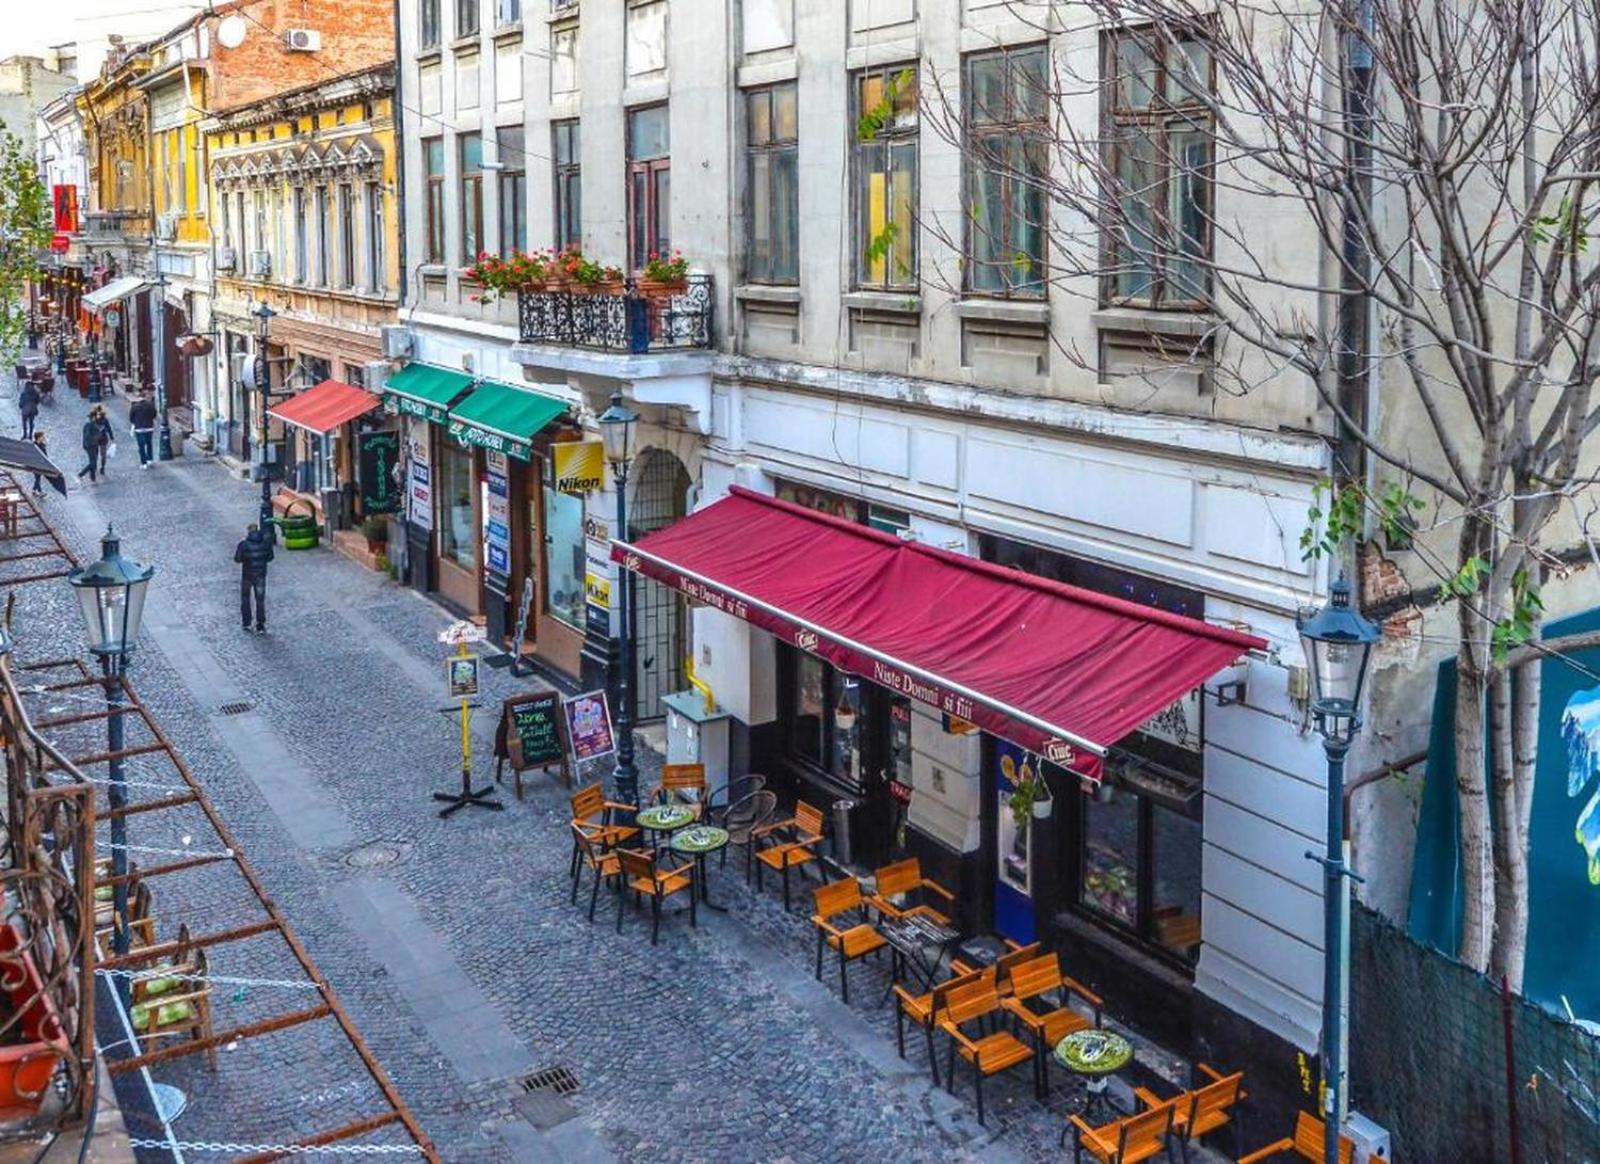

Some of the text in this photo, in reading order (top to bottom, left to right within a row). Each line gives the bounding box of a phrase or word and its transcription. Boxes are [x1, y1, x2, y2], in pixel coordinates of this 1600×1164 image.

[558, 477, 600, 493] Nikon
[873, 661, 901, 688] Niste
[902, 674, 939, 705] Domni
